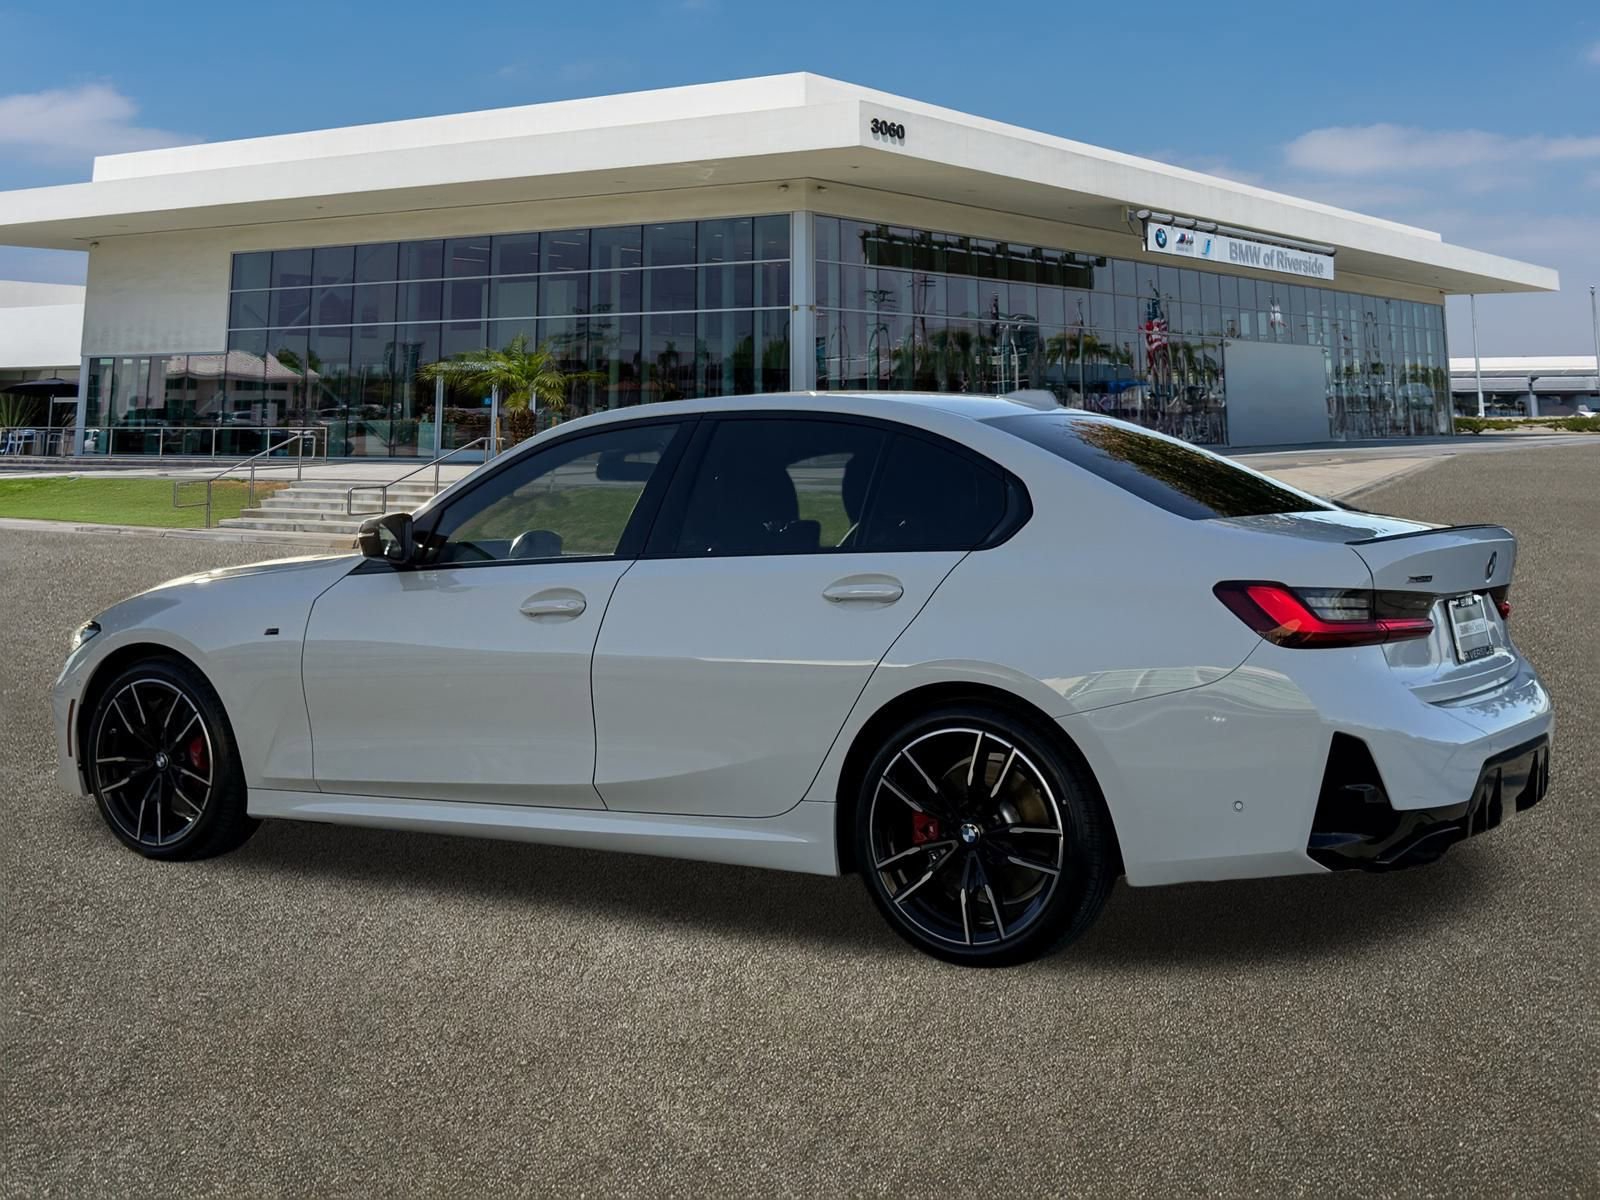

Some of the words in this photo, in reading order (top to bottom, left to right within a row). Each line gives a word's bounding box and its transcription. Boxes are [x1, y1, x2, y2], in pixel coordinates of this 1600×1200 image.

[871, 118, 905, 139] 3060
[1229, 241, 1261, 265] BMW
[1263, 249, 1275, 266] of
[1276, 250, 1324, 275] Riverside
